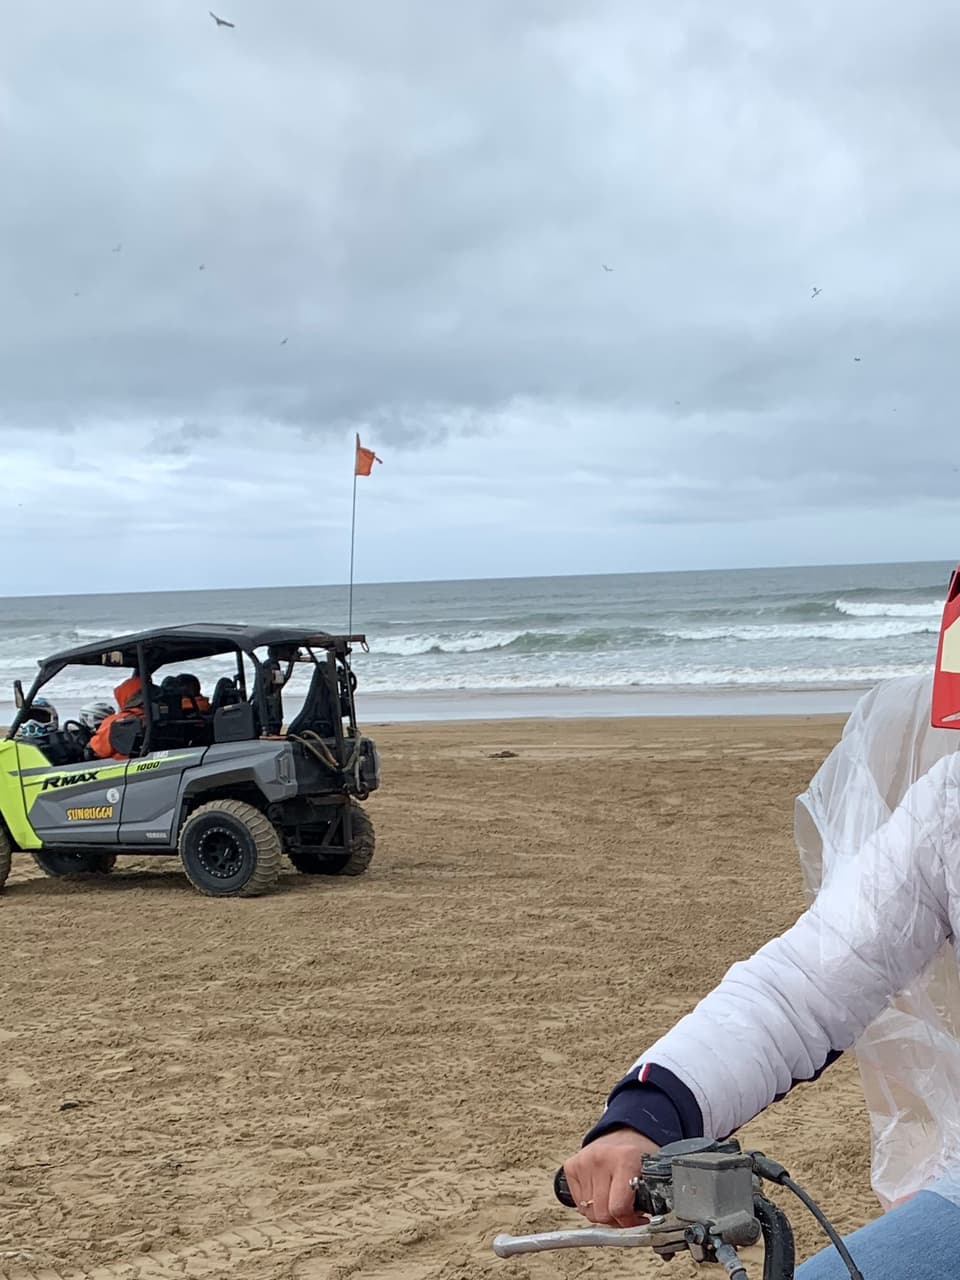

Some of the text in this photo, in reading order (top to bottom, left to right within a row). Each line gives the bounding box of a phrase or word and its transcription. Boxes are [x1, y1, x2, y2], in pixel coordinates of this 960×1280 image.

[42, 761, 160, 790] RMAX 1000
[66, 805, 113, 821] SUNBUGGY
